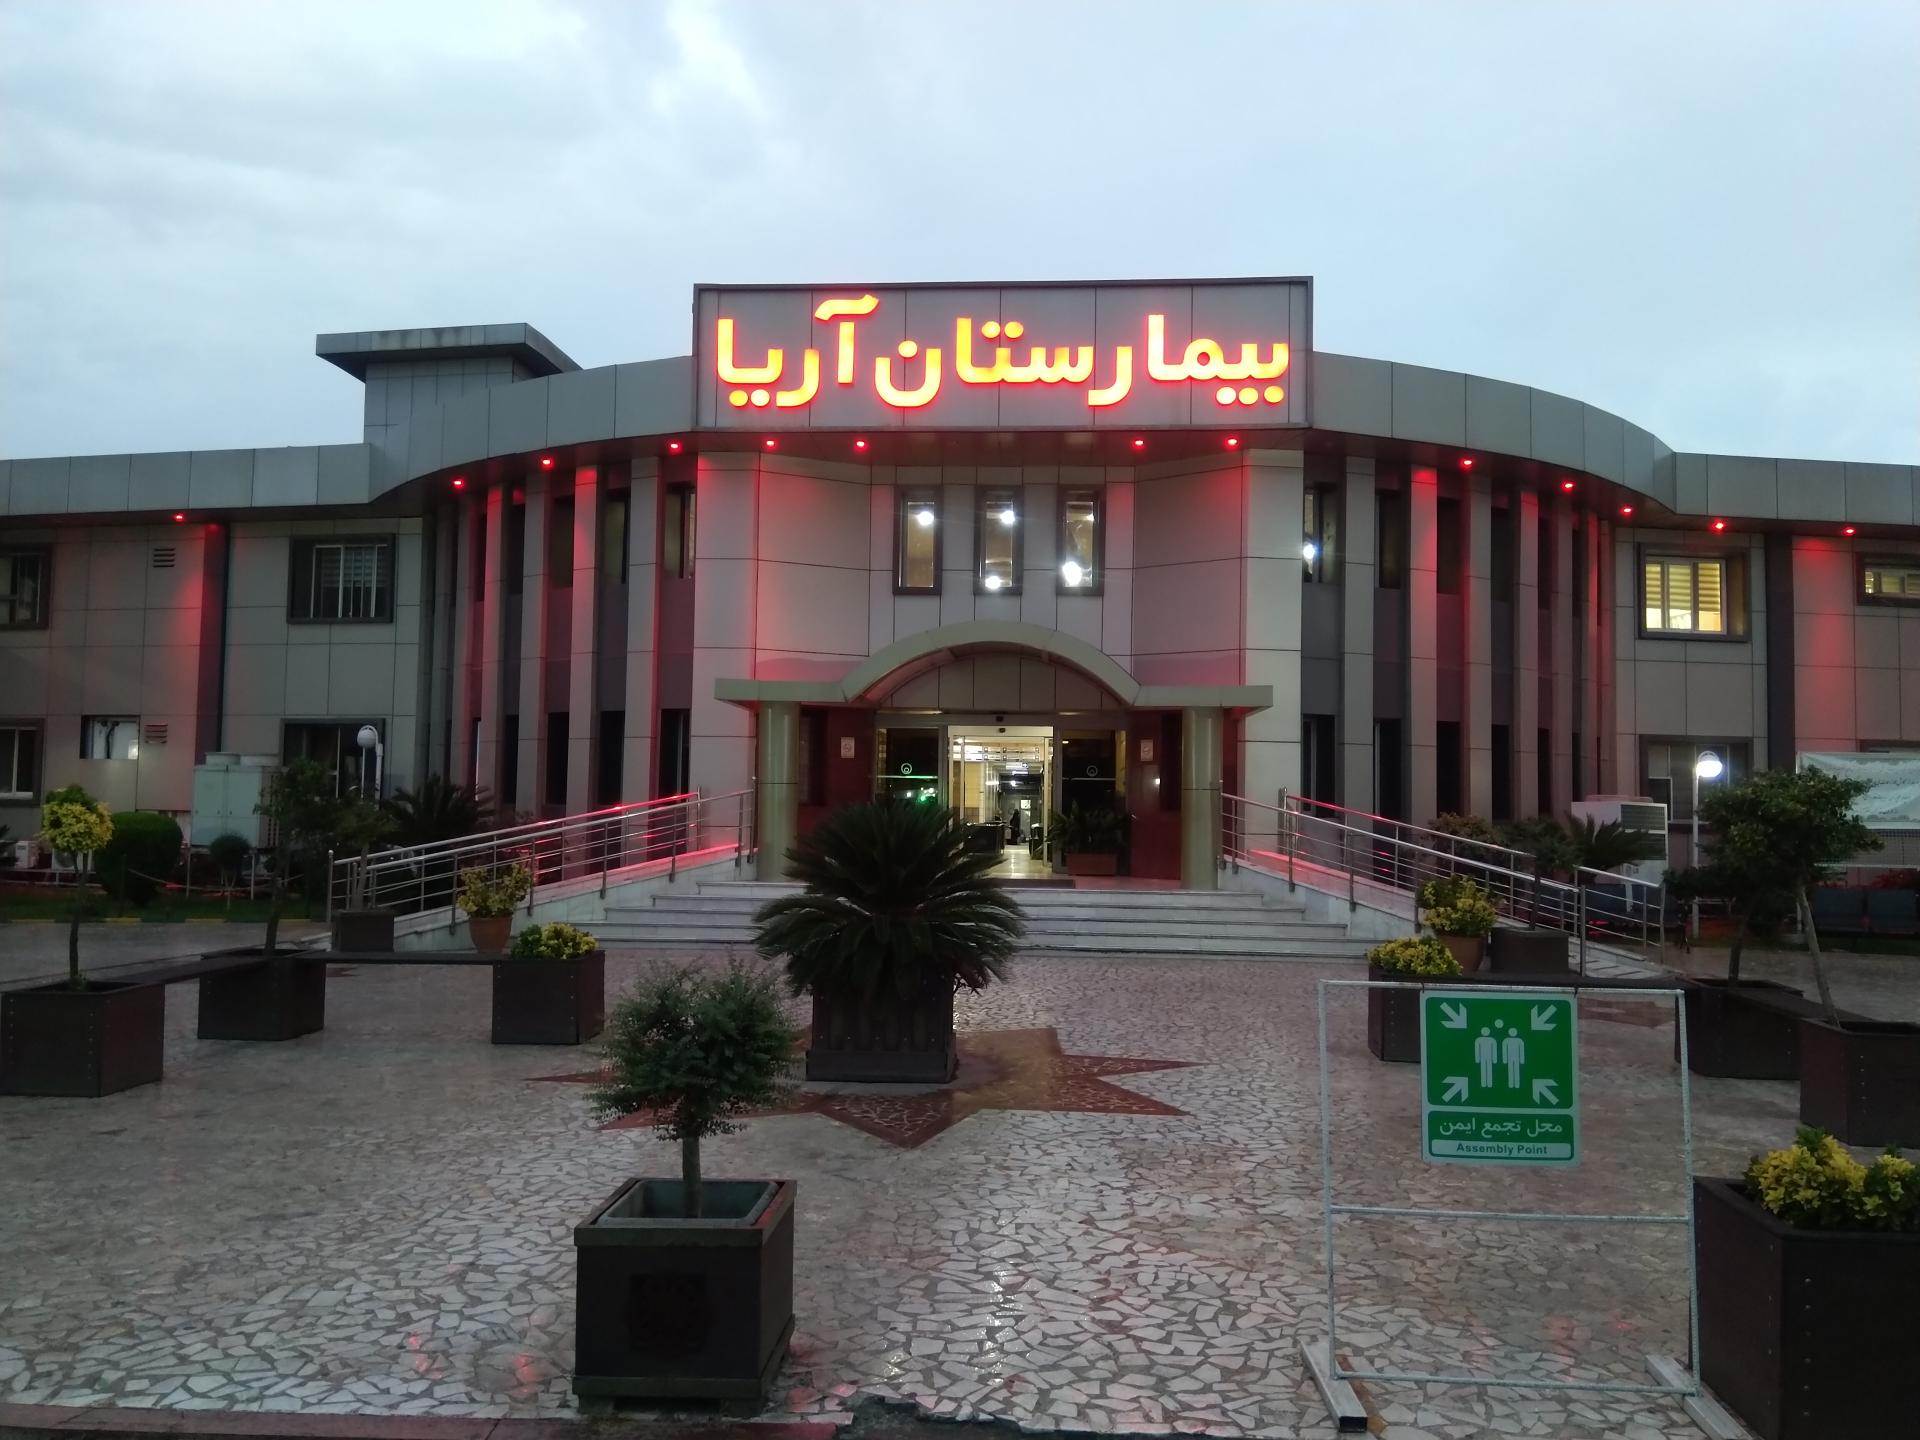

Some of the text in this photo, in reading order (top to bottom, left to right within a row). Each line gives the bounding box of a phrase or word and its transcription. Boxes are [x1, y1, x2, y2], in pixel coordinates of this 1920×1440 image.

[716, 294, 1290, 408] بیمارستان آریا
[1439, 1117, 1563, 1138] محل تجمع ایمن
[1456, 1143, 1548, 1155] Assembly Point
